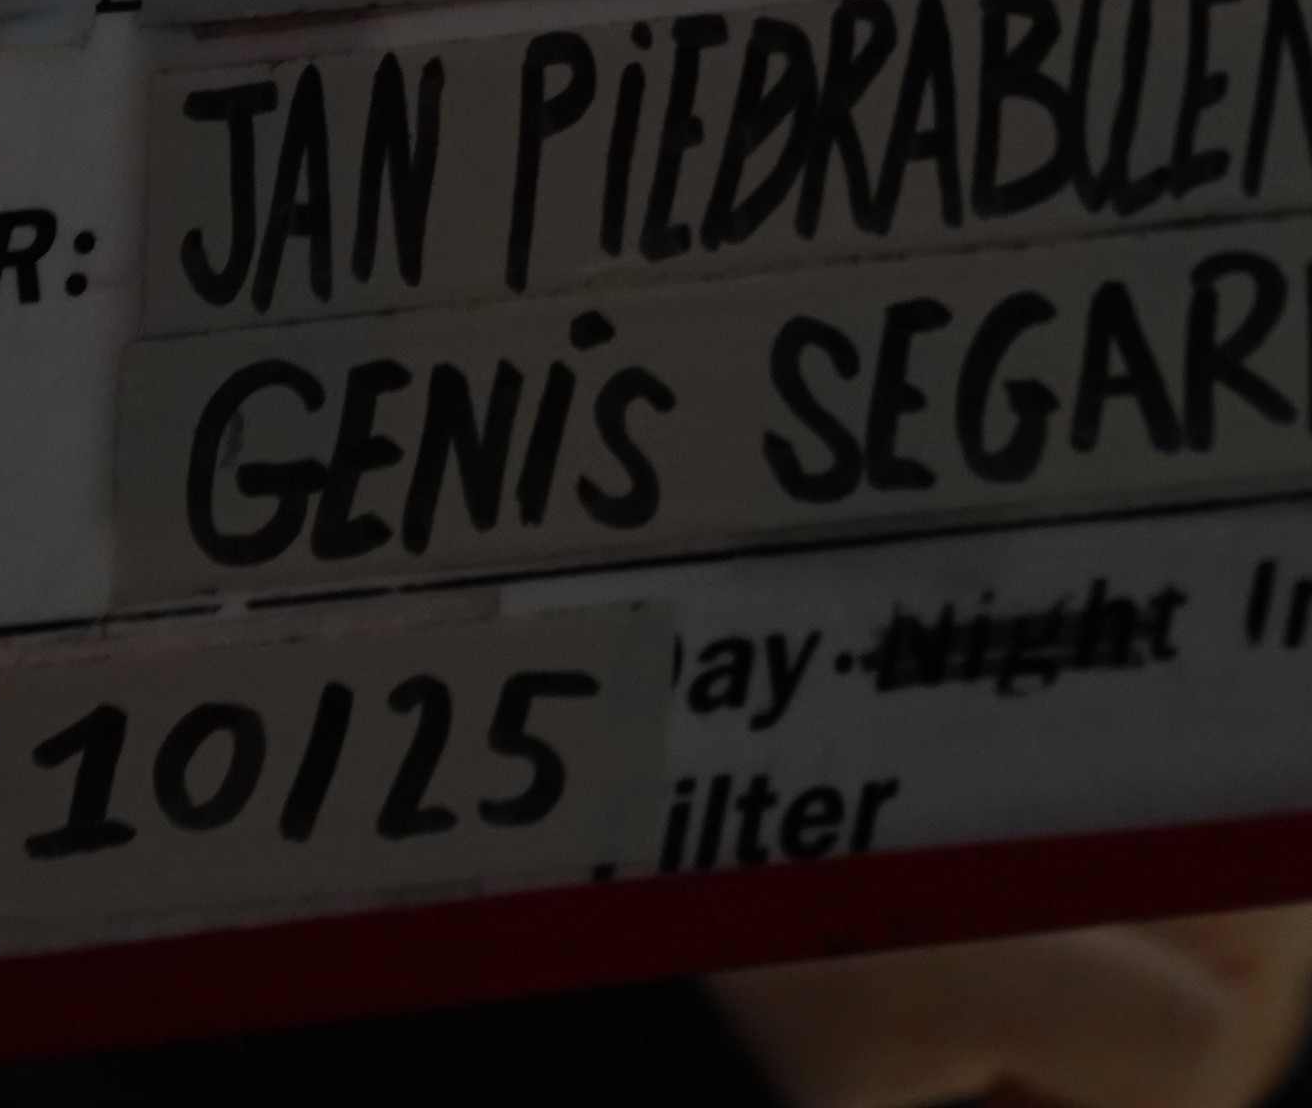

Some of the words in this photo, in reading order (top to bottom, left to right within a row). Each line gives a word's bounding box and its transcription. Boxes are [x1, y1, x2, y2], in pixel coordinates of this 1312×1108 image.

[179, 52, 444, 312] JAN
[672, 628, 823, 732] ay
[594, 773, 901, 882] ilter
